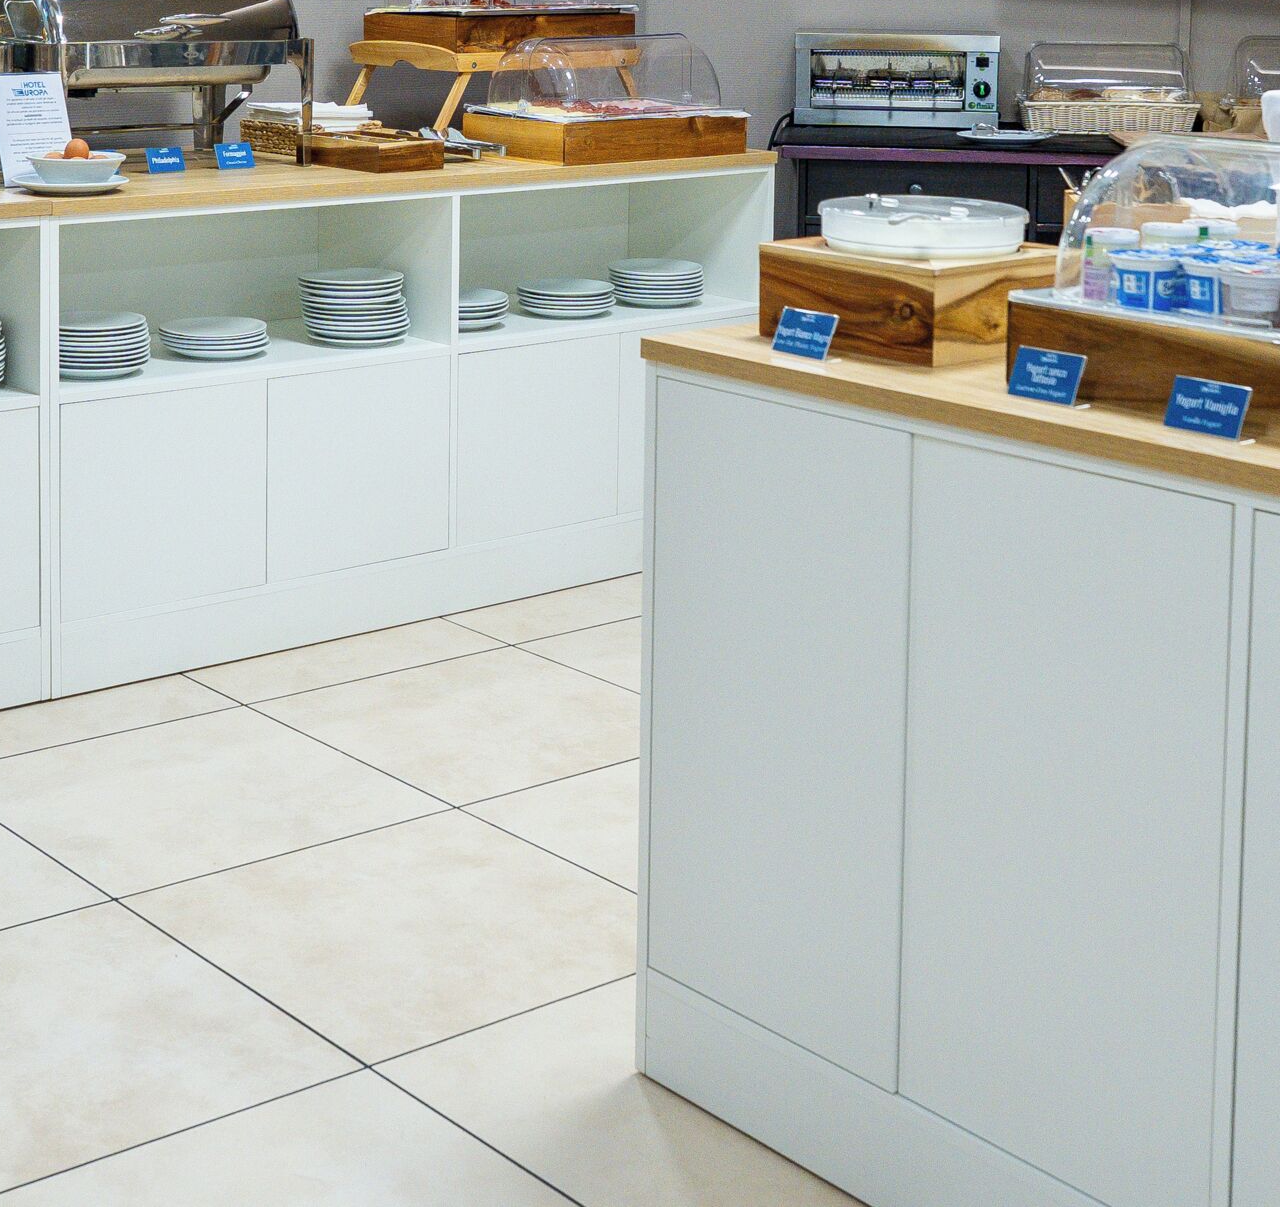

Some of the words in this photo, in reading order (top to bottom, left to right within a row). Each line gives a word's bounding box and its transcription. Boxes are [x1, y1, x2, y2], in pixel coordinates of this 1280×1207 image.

[23, 81, 46, 89] HOTEL
[151, 156, 180, 164] Philadelphia
[1025, 361, 1049, 375] Yogurt
[1176, 393, 1204, 410] Yogurt
[1204, 397, 1239, 416] Vaniglia
